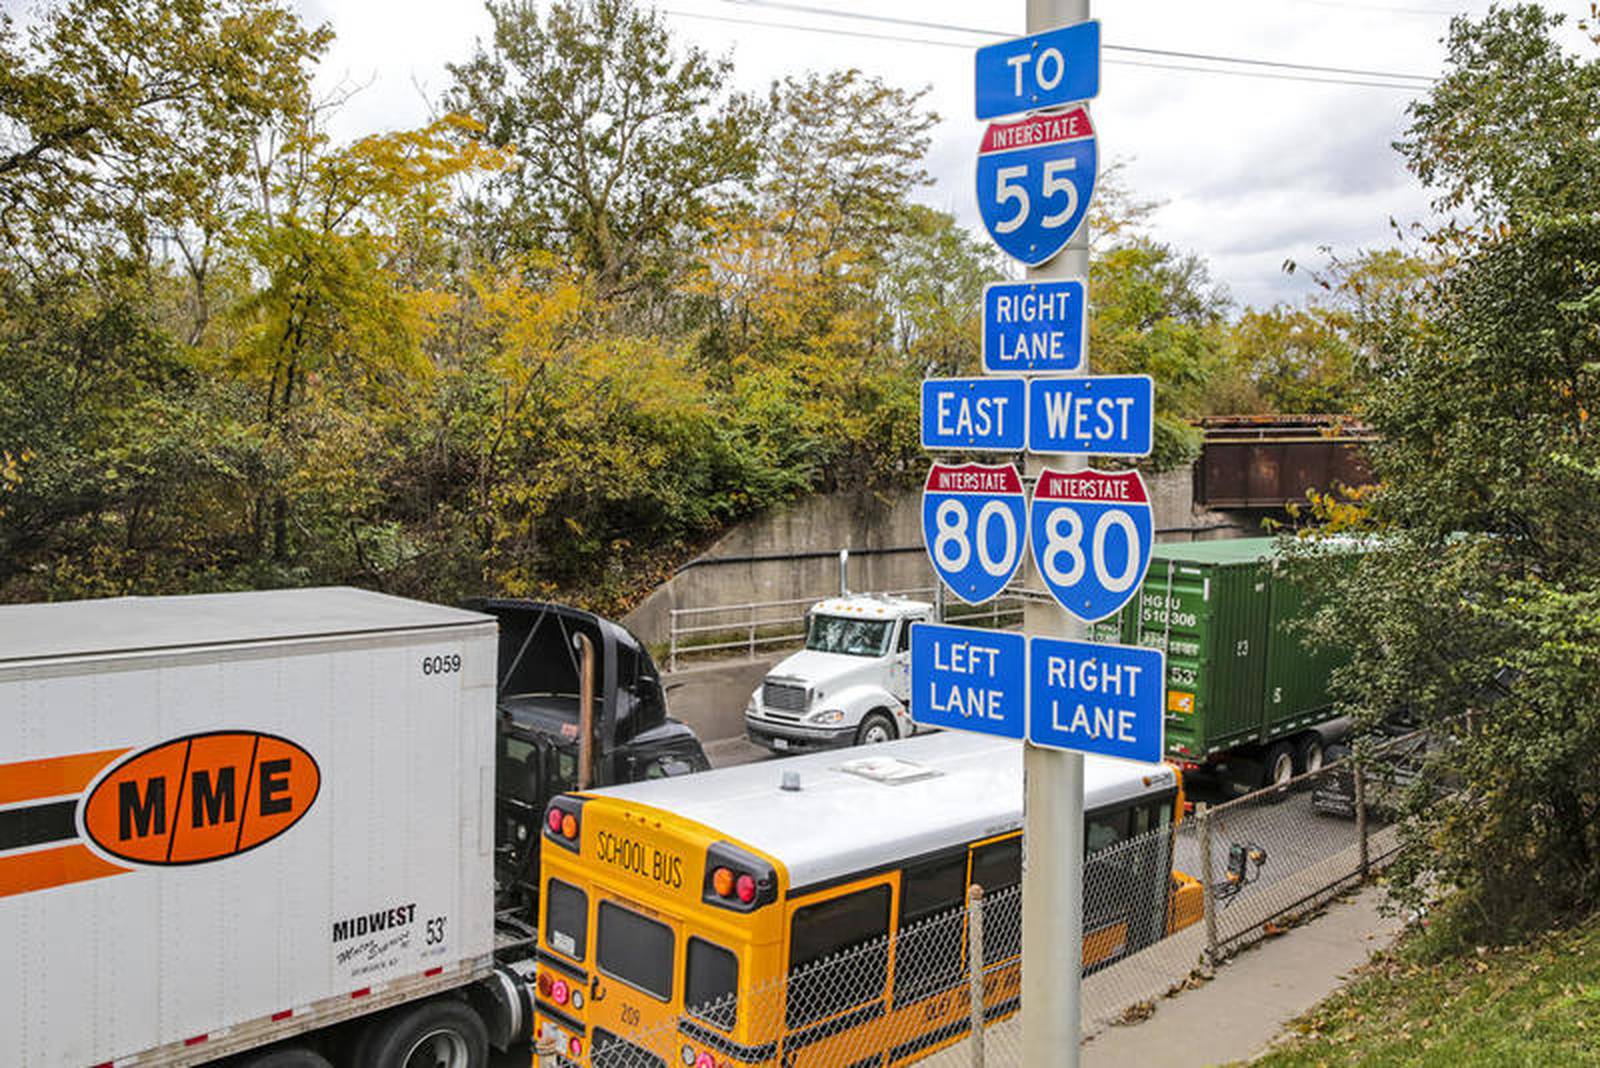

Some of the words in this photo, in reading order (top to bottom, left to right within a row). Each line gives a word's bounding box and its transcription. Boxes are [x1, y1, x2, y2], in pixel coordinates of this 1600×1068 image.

[1007, 48, 1065, 96] TO
[992, 117, 1079, 149] INTERSTATE
[994, 158, 1078, 234] 55
[997, 292, 1070, 323] RIGHT
[999, 332, 1064, 361] LANE
[937, 392, 1008, 436] EAST
[1045, 392, 1134, 440] WEST
[939, 473, 1007, 491] INTERSTATE
[1050, 479, 1129, 499] INTERSTATE
[934, 499, 1017, 577] 80
[1043, 507, 1140, 593] 80
[423, 654, 461, 675] 6059
[934, 641, 1000, 677] LEFT
[1048, 656, 1142, 697] RIGHT
[931, 682, 1004, 720] LANE
[1052, 700, 1136, 743] LANE
[597, 831, 649, 877] SCHOOL
[653, 850, 682, 888] BUS
[332, 904, 416, 942] MIDWEST
